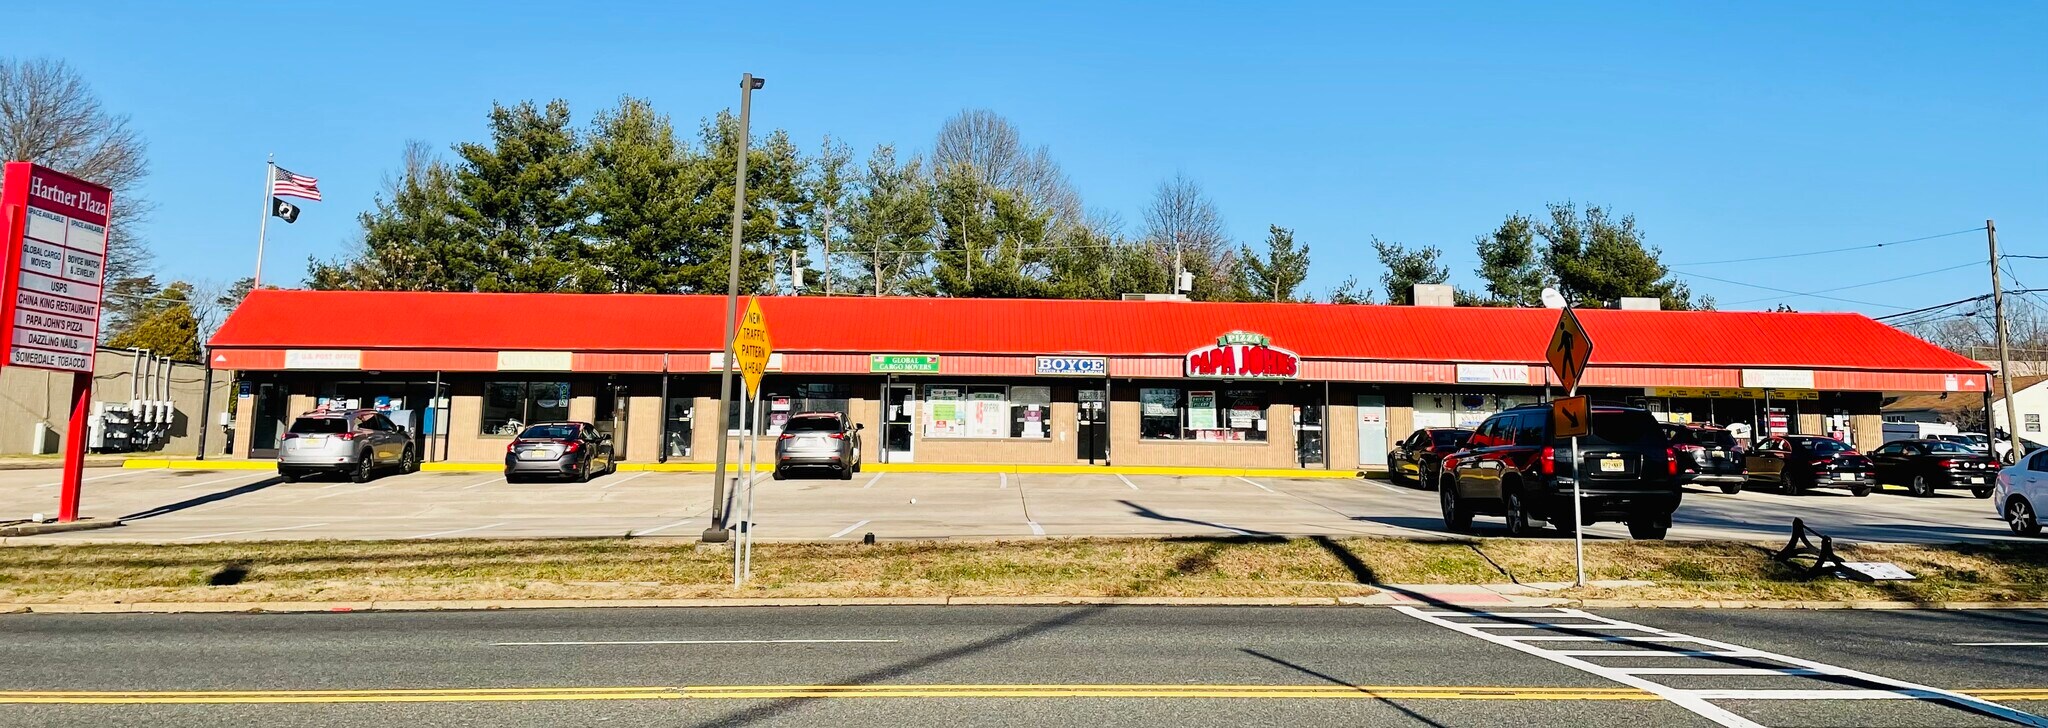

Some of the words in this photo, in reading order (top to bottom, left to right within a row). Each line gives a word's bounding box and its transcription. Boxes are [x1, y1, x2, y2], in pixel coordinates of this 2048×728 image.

[30, 175, 77, 207] Hartner
[78, 191, 106, 216] Plaza
[28, 207, 42, 217] SPACE
[42, 211, 64, 223] AVAILABLE
[71, 219, 84, 229] SPACE
[84, 223, 104, 234] AVAILABLE
[23, 244, 43, 256] GLOBAL
[43, 249, 62, 261] CARGO
[30, 257, 52, 269] MOVERS
[67, 254, 84, 265] BOYCE
[84, 258, 100, 269] WATCH
[74, 267, 96, 279] JEWELRY
[51, 281, 68, 293] USPS
[18, 293, 38, 306] CHINA
[39, 297, 55, 309] KING
[55, 300, 95, 316] RESTAURANT
[25, 314, 42, 326] PAPA
[43, 317, 66, 330] JOHN'S
[66, 321, 83, 332] PIZZA
[749, 312, 760, 324] NEW
[28, 333, 59, 347] DAZZLING
[60, 338, 78, 349] NAILS
[743, 327, 765, 342] TRAFFIC
[1227, 333, 1261, 343] PIZZA
[742, 344, 765, 358] PATTERN
[15, 351, 55, 366] SOMERDALE
[58, 356, 86, 369] TOBACCO
[1038, 358, 1104, 370] BOYCE
[1190, 346, 1236, 376] PAPA
[745, 362, 763, 374] AHEAD
[1492, 367, 1528, 381] NAILS
